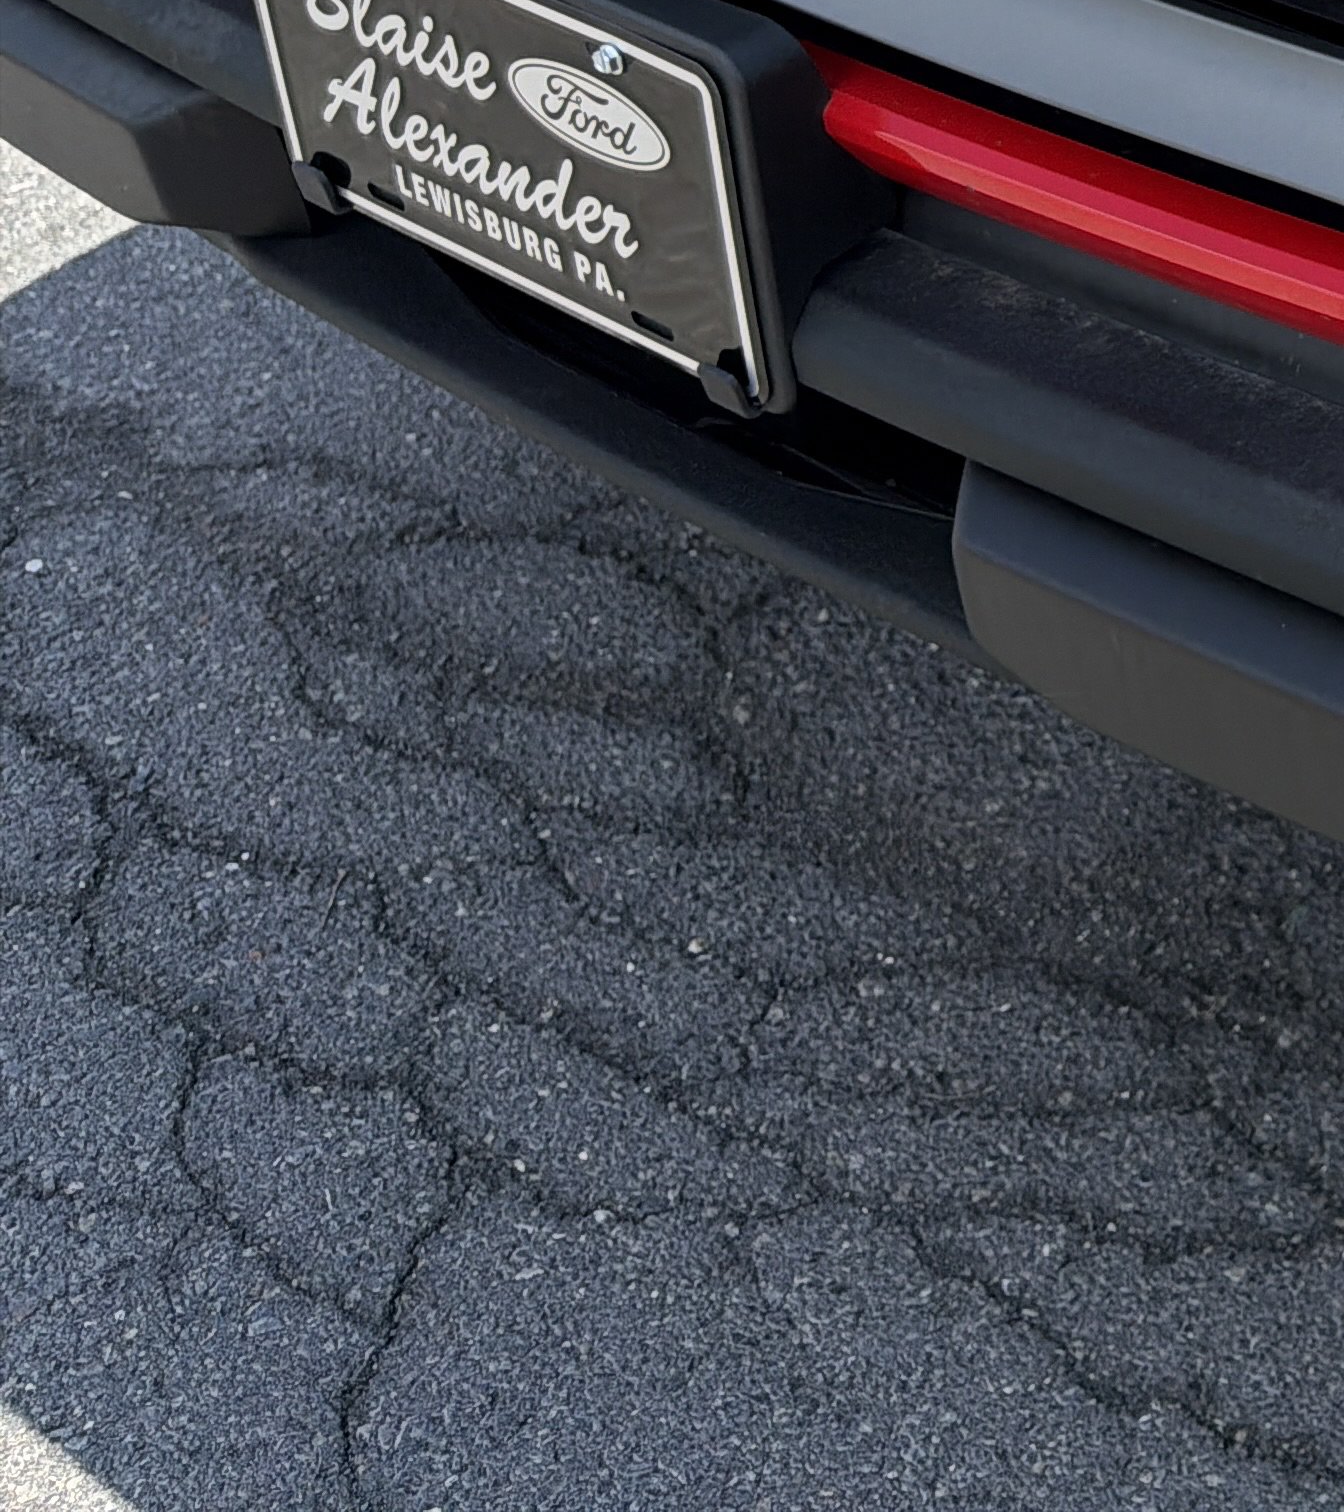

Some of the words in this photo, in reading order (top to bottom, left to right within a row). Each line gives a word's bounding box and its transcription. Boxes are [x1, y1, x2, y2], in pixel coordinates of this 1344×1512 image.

[322, 57, 639, 260] Alexander
[539, 73, 638, 159] Ford
[394, 164, 564, 273] LEWISBURG
[574, 250, 627, 303] PA.
